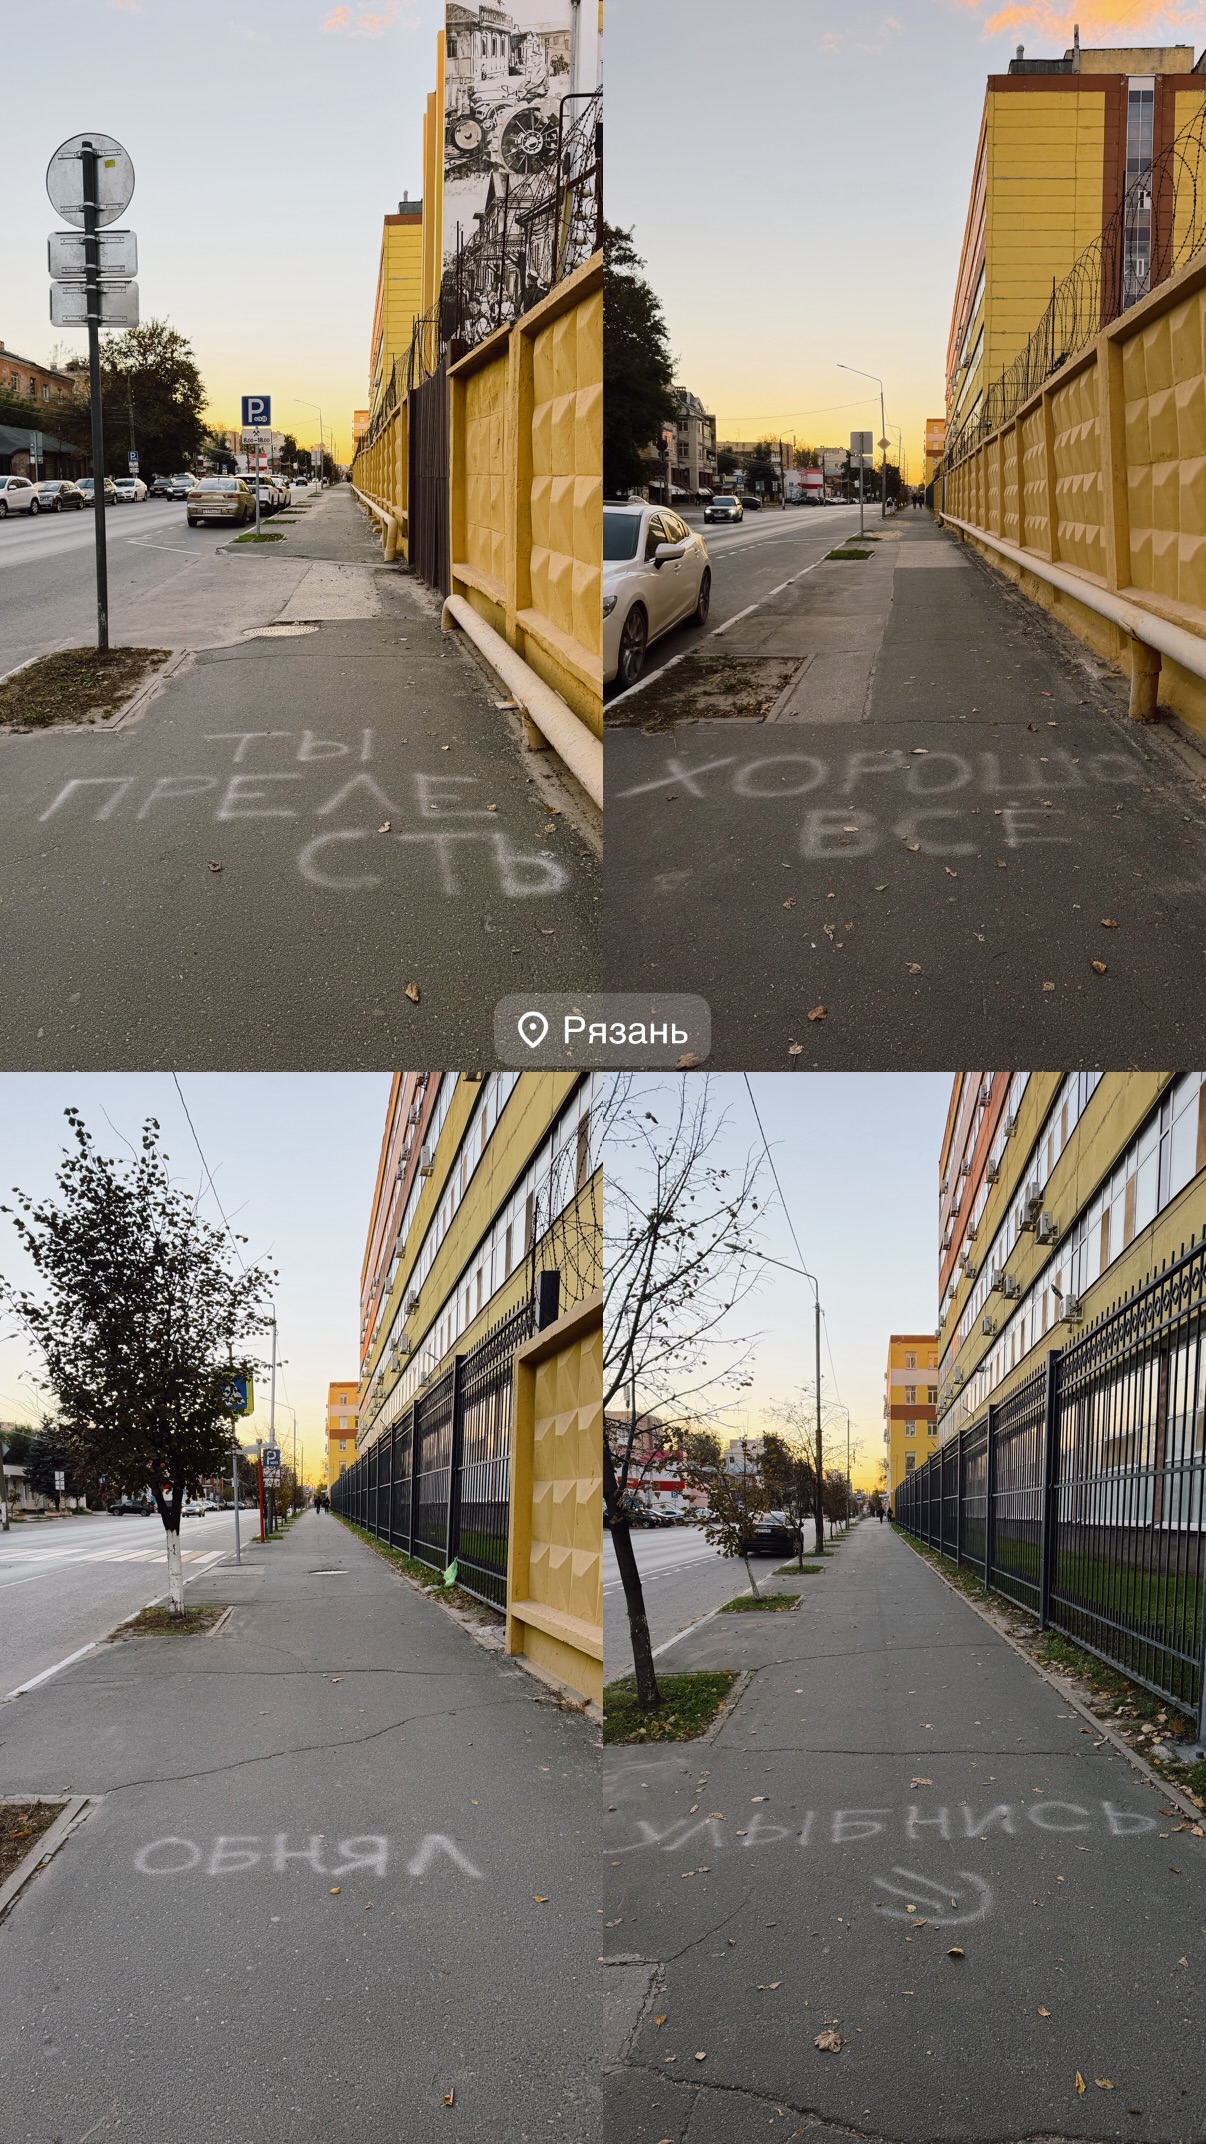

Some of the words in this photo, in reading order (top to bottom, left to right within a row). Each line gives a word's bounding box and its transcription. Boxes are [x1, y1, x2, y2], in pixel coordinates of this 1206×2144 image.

[248, 398, 265, 423] P
[203, 728, 373, 764] ТЫ
[38, 774, 498, 823] ПРЕЛЕ
[299, 828, 570, 899] СТЬ
[266, 1450, 277, 1465] P
[602, 1800, 1158, 1854] УЛЫБНИСЬ
[134, 1834, 485, 1877] ОБНЯЛ
